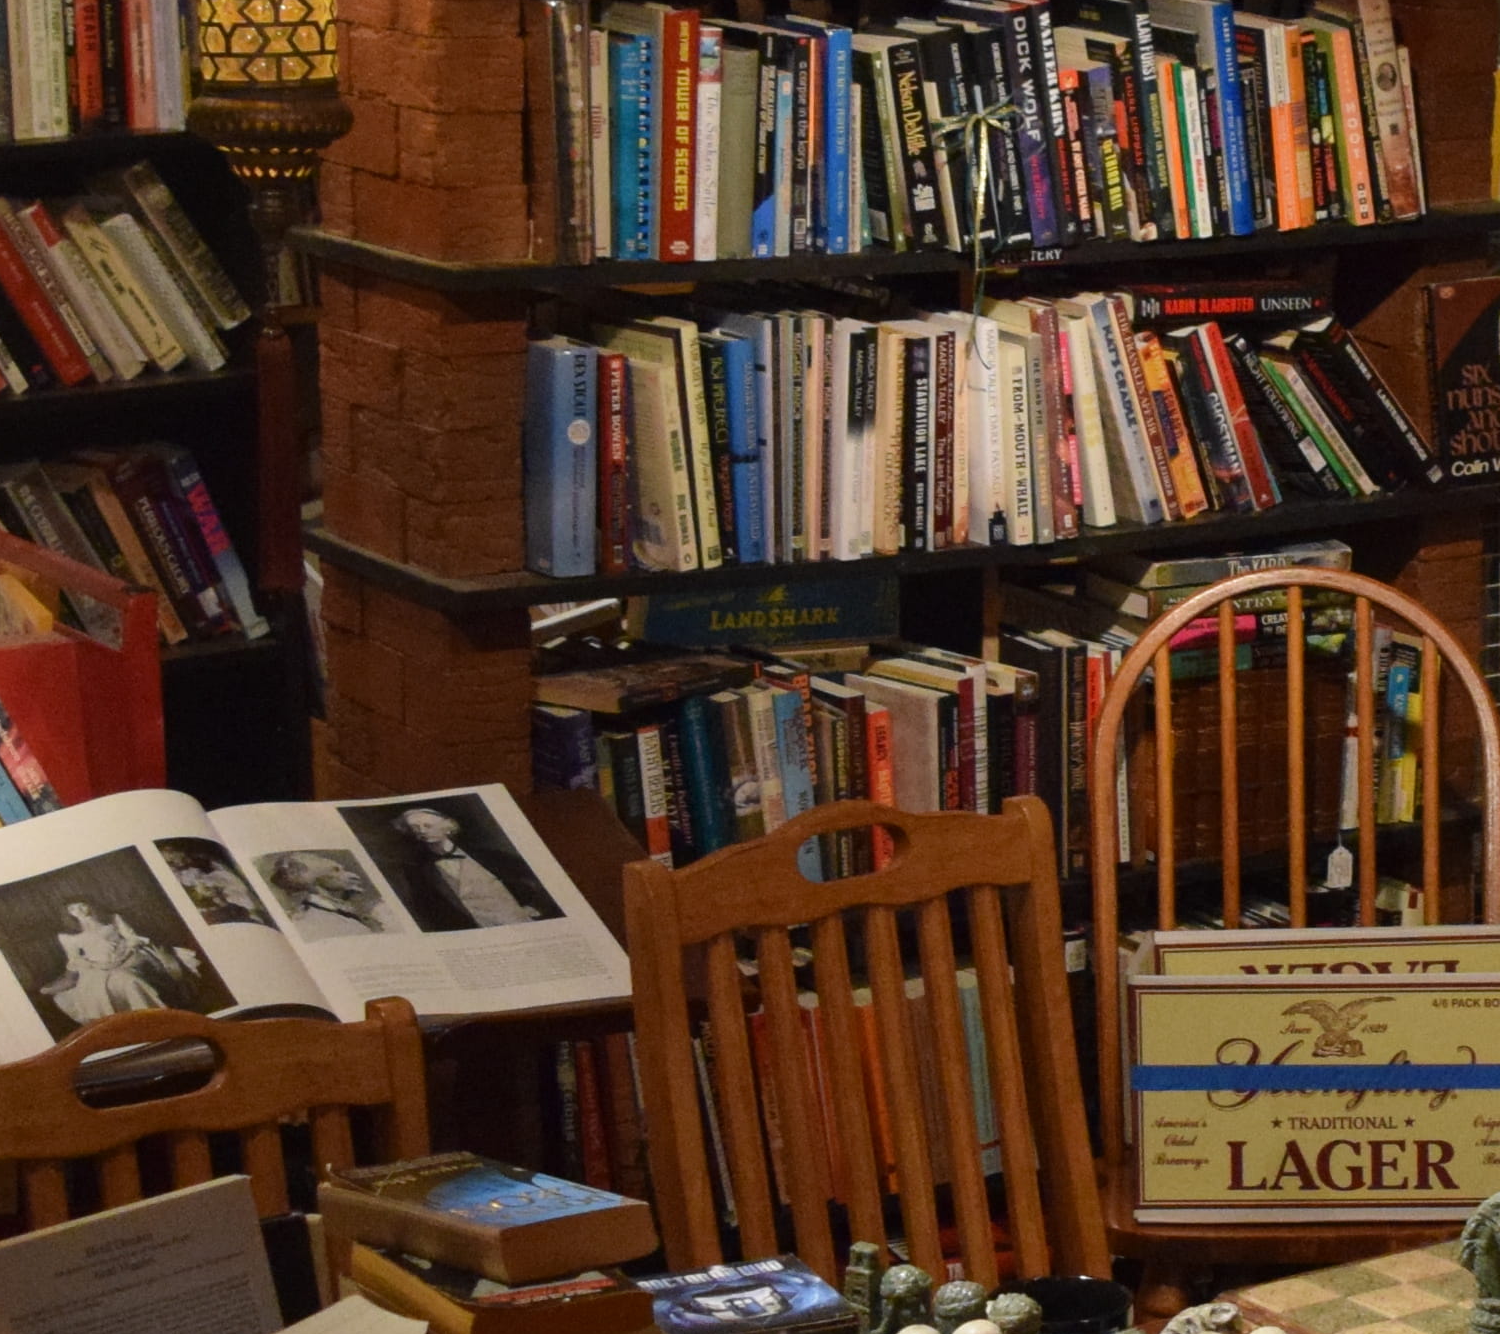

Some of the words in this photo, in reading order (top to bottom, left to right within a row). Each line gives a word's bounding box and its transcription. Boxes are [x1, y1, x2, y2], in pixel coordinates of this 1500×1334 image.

[1012, 16, 1032, 74] DICK
[1039, 10, 1059, 87] WALTER
[1135, 13, 1152, 43] ALAN
[1137, 43, 1156, 83] FURST
[675, 67, 691, 121] TOWER
[897, 70, 923, 110] Nelson
[1020, 78, 1042, 143] WOLF
[674, 125, 690, 144] OF
[902, 112, 926, 157] DeMille
[1047, 88, 1066, 138] KIRN
[673, 147, 689, 211] SECRETS
[1164, 297, 1198, 316] KARIN
[1199, 296, 1255, 315] SLAUGHTER
[1260, 295, 1312, 313] UNSEEN
[610, 370, 622, 412] PETER
[1101, 324, 1123, 367] KAT'S
[1113, 370, 1138, 429] CRADLE
[1461, 363, 1492, 386] six
[1011, 378, 1025, 415] FROM
[611, 414, 623, 460] BOWEN
[1013, 423, 1027, 470] MOUTH
[1207, 391, 1242, 475] GHOSTMAN
[1450, 458, 1490, 478] Colin
[1016, 478, 1029, 518] WHALE
[1450, 998, 1482, 1009] PACK
[1287, 1116, 1398, 1130] TRADITIONAL
[1227, 1139, 1460, 1192] LAGER
